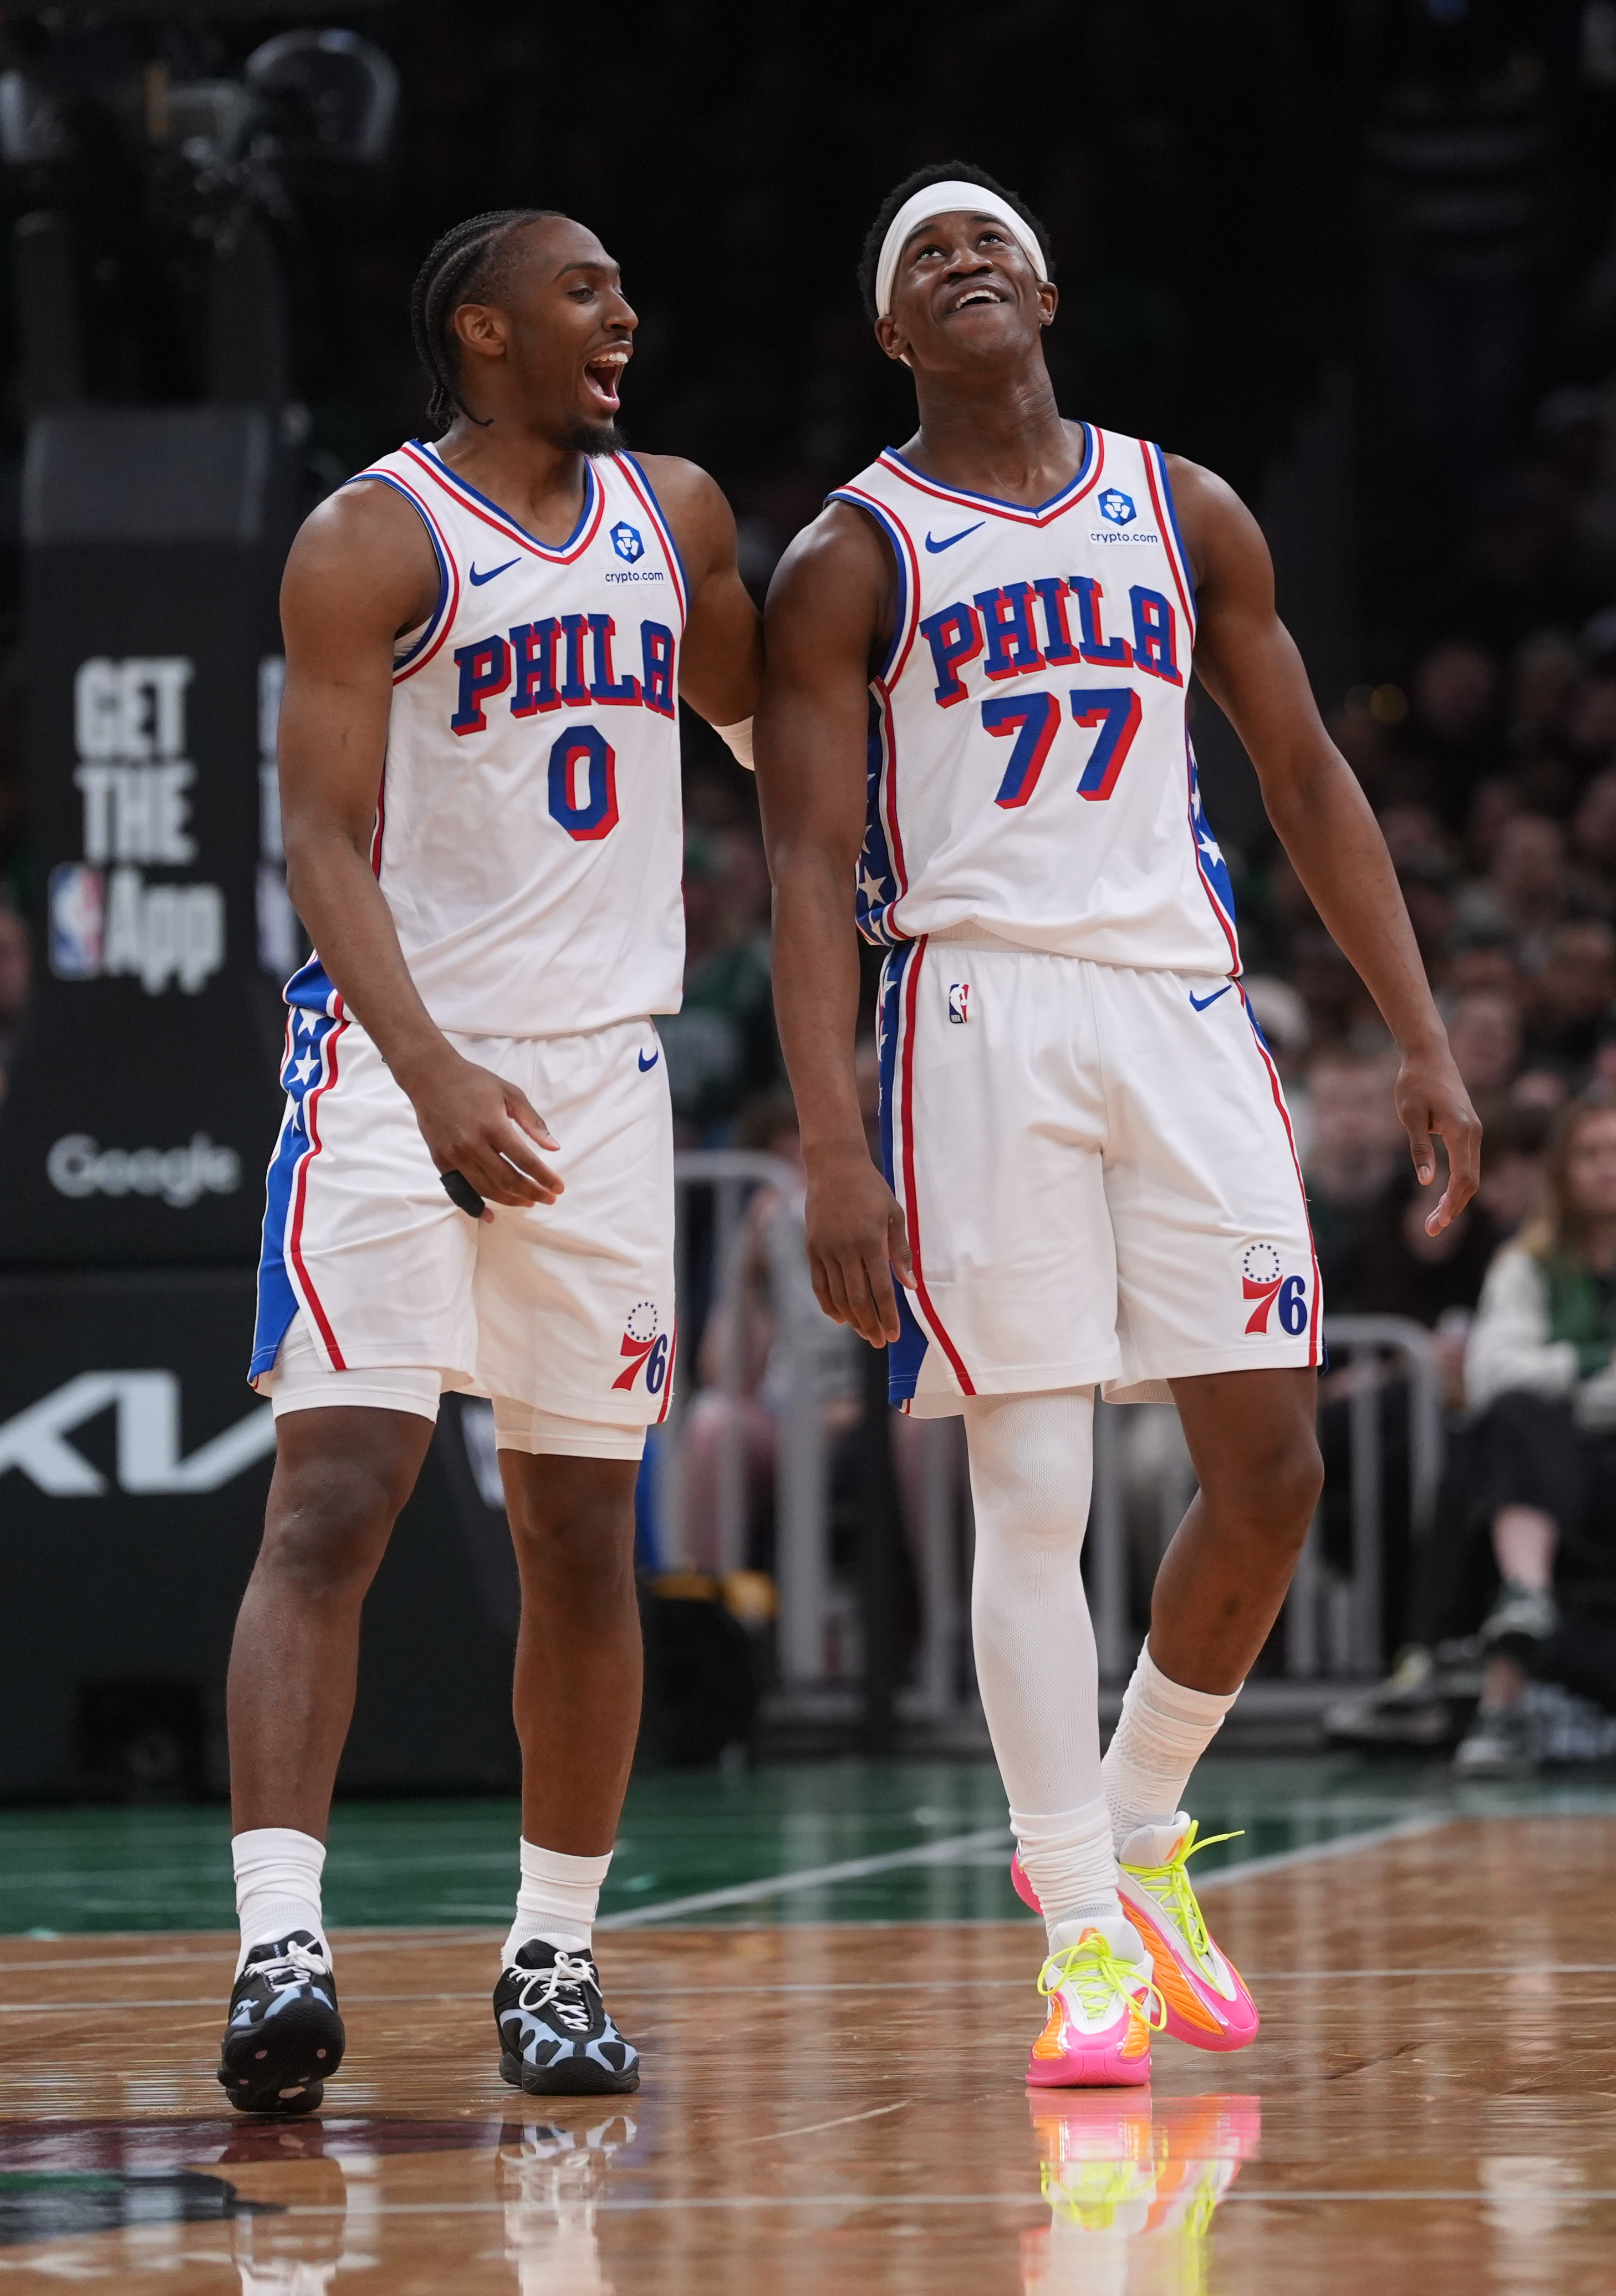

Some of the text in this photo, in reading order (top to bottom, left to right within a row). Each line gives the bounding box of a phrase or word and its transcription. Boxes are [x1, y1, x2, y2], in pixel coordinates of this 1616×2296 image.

[605, 571, 664, 584] crypto.com
[1090, 532, 1158, 543] crypto.com
[450, 613, 675, 736] PHILA
[919, 575, 1184, 709] PHILA
[74, 655, 194, 760] GET
[981, 687, 1143, 810] 77
[73, 762, 197, 866] THE
[547, 724, 619, 842] 0
[105, 866, 224, 994] App
[950, 1014, 961, 1022] NBA
[47, 1131, 242, 1209] Google
[1242, 1274, 1308, 1336] 76
[611, 1331, 668, 1394] 76
